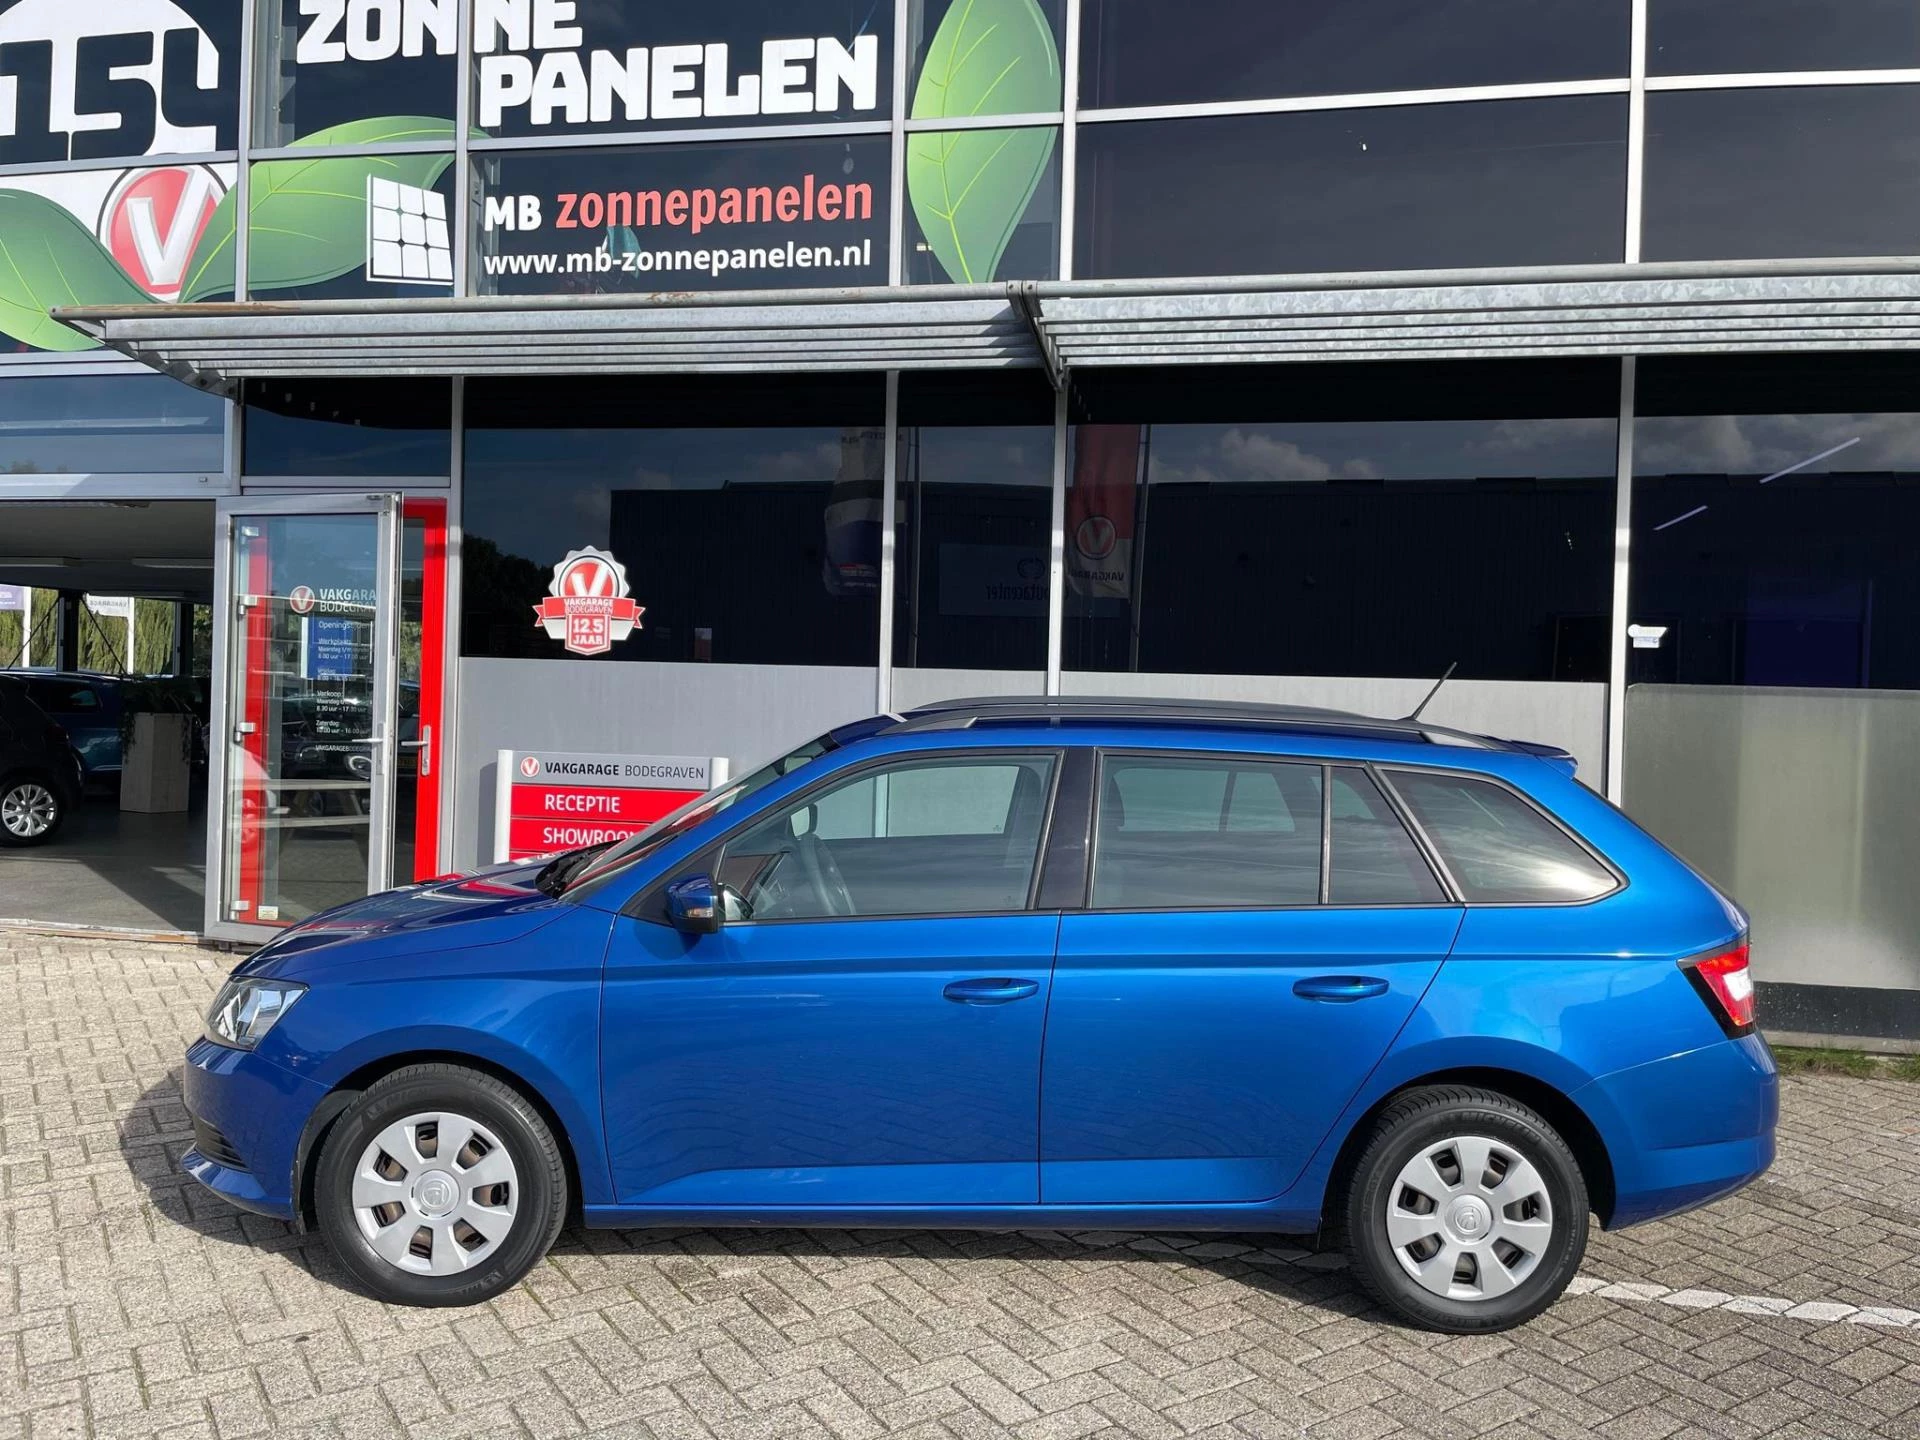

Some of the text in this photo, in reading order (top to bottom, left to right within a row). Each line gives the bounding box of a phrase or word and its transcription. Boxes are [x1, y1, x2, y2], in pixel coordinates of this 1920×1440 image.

[480, 35, 878, 127] PANELEN
[484, 174, 873, 235] MB zonnepanelen
[484, 240, 872, 277] www.mb-zonnepanelen.nl
[565, 598, 613, 607] VAKGARAGE
[574, 634, 603, 645] JAAR
[545, 762, 620, 776] VAKGARAGE
[625, 765, 704, 779] BODEGRAVEN
[544, 793, 620, 813] RECEPTIE
